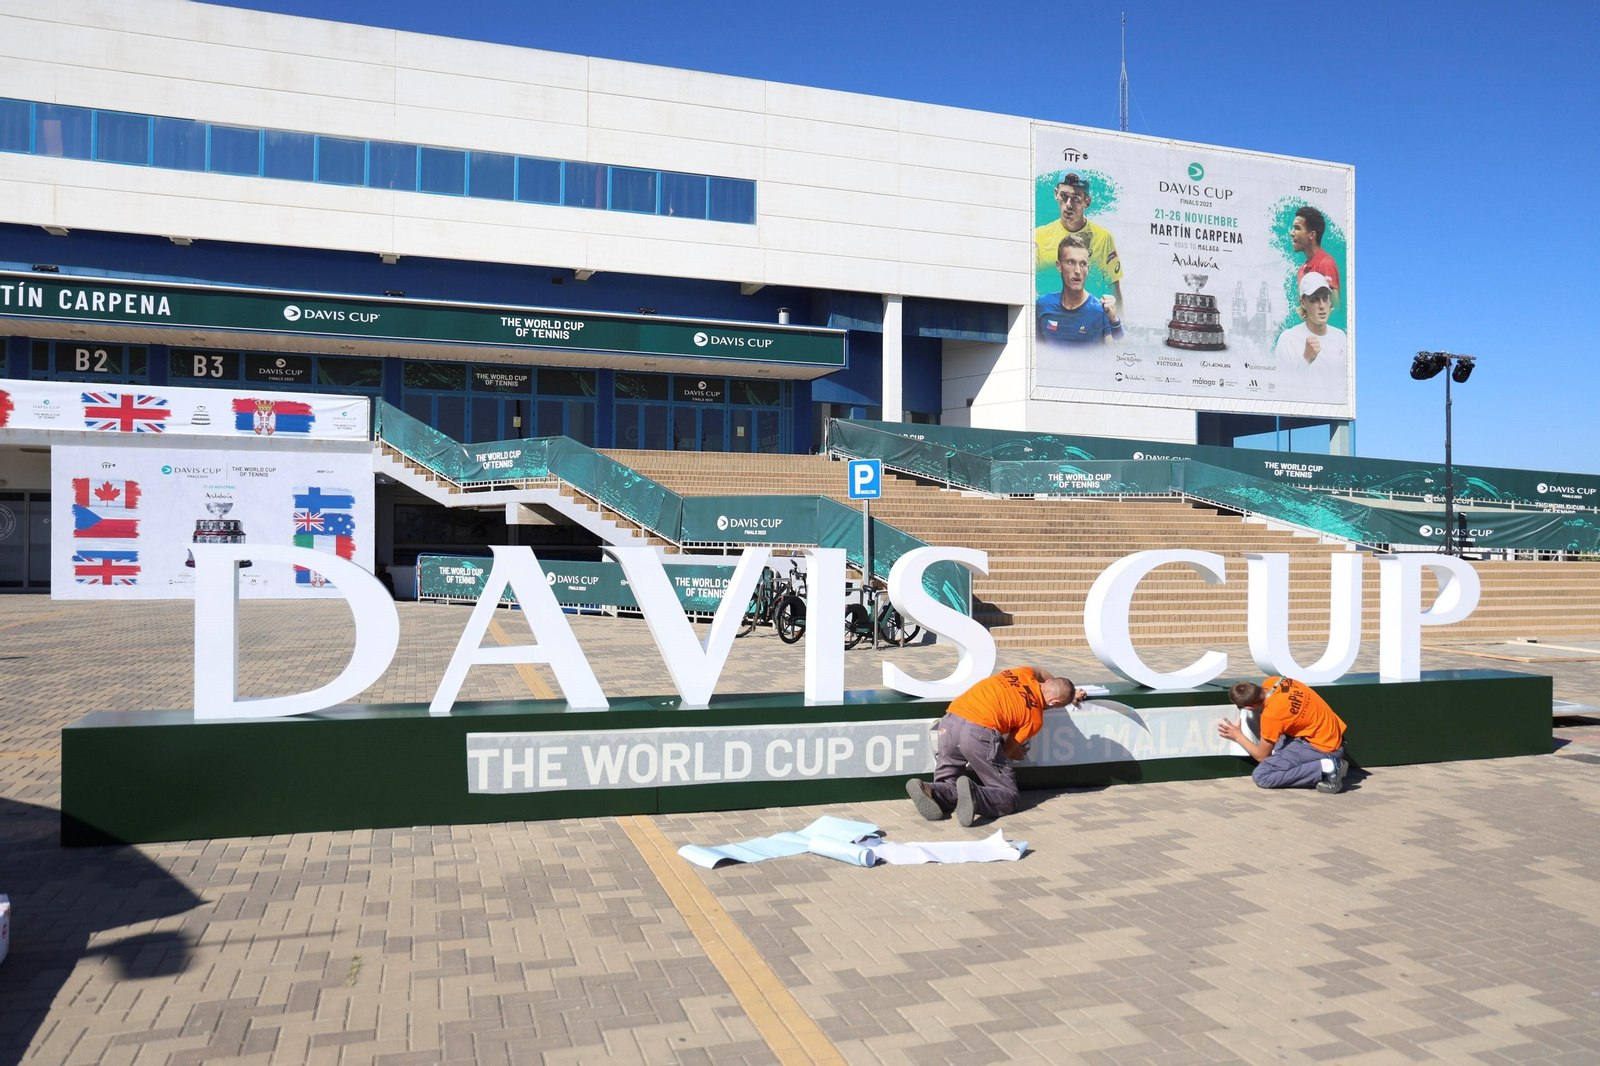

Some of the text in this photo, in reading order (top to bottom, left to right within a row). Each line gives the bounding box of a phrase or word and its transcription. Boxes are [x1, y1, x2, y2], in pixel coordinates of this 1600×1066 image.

[1064, 152, 1080, 162] ITF
[1159, 181, 1234, 200] DAVIS CUP
[1154, 208, 1238, 228] 21-26 NOVIEMBRE
[1150, 222, 1243, 244] MARTÍN CARPENA
[0, 282, 171, 316] TÍN CARPENA
[304, 309, 379, 323] DAVIS CUP
[500, 317, 584, 330] THE WORLD CUP
[516, 328, 570, 339] OF TENNIS
[711, 336, 772, 348] DAVIS CUP
[76, 349, 108, 372] B2
[193, 355, 224, 378] B3
[476, 453, 486, 462] THE
[487, 451, 508, 461] WORLD
[509, 450, 521, 459] CUP
[491, 460, 513, 469] TENNIS
[1280, 463, 1307, 471] WORLD
[854, 464, 874, 494] P
[1285, 470, 1312, 478] TENNIS
[1550, 485, 1575, 494] DAVIS
[730, 519, 781, 528] DAVIS CUP
[451, 568, 471, 576] WORLD
[455, 576, 475, 584] TENNIS
[557, 576, 598, 585] DAVIS CUP
[675, 577, 690, 586] THE
[692, 578, 720, 587] WORLD
[686, 588, 695, 597] OF
[185, 543, 1481, 720] DAVIS CUP
[468, 746, 568, 790] THE
[581, 740, 752, 785] WORLD
[766, 736, 854, 778] CUP
[865, 734, 920, 774] OF
[1105, 713, 1232, 758] MÁLAG
